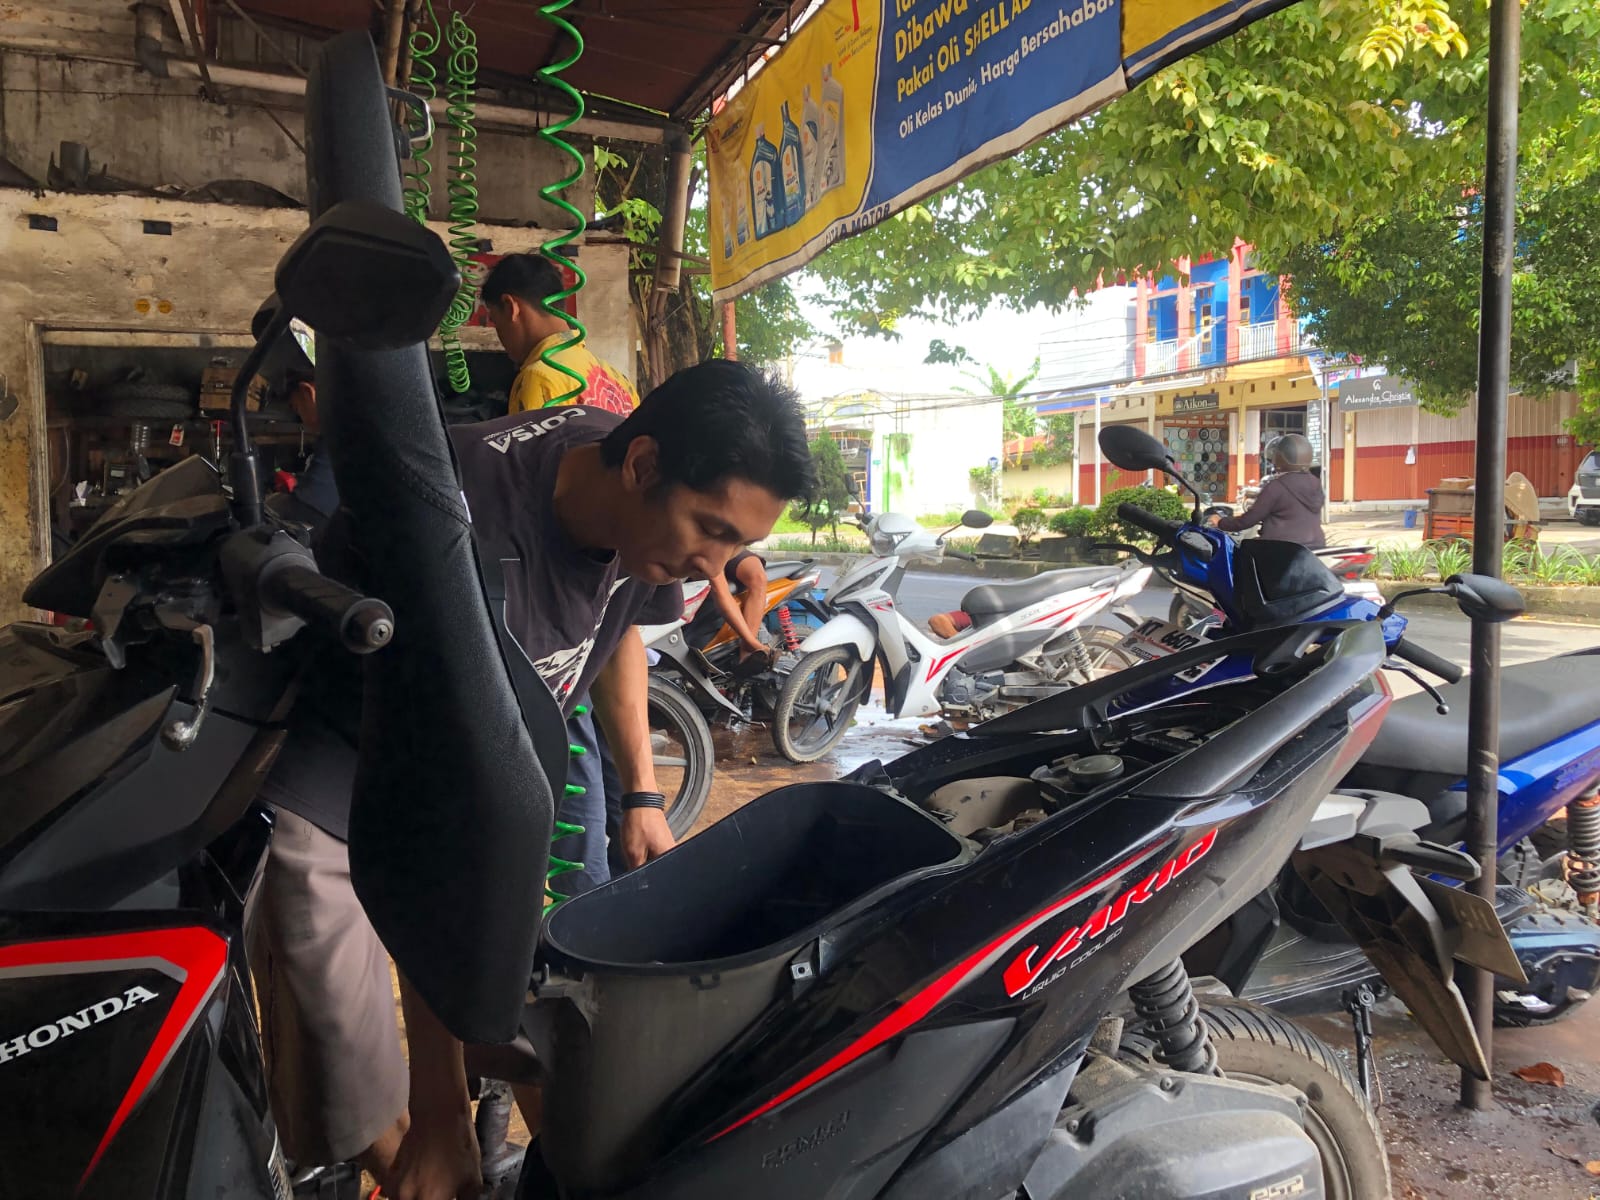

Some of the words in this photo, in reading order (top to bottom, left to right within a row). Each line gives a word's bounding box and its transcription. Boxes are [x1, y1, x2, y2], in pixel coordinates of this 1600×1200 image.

[895, 0, 968, 63] Dibawa
[897, 54, 934, 102] Pakai
[937, 36, 960, 72] Oli
[964, 2, 1009, 56] SHELL
[900, 111, 913, 138] Oli
[915, 101, 943, 129] Kelas
[945, 77, 977, 111] Dunia,
[981, 48, 1020, 86] Harga
[1021, 0, 1114, 59] Bersahaba
[1183, 397, 1208, 409] Aikon
[1345, 393, 1380, 406] Alexandre
[1381, 390, 1412, 404] Christie
[1003, 828, 1218, 998] VARIO
[1022, 967, 1067, 1000] LIQUID
[1069, 926, 1124, 969] COOLED
[0, 985, 159, 1064] HONDA
